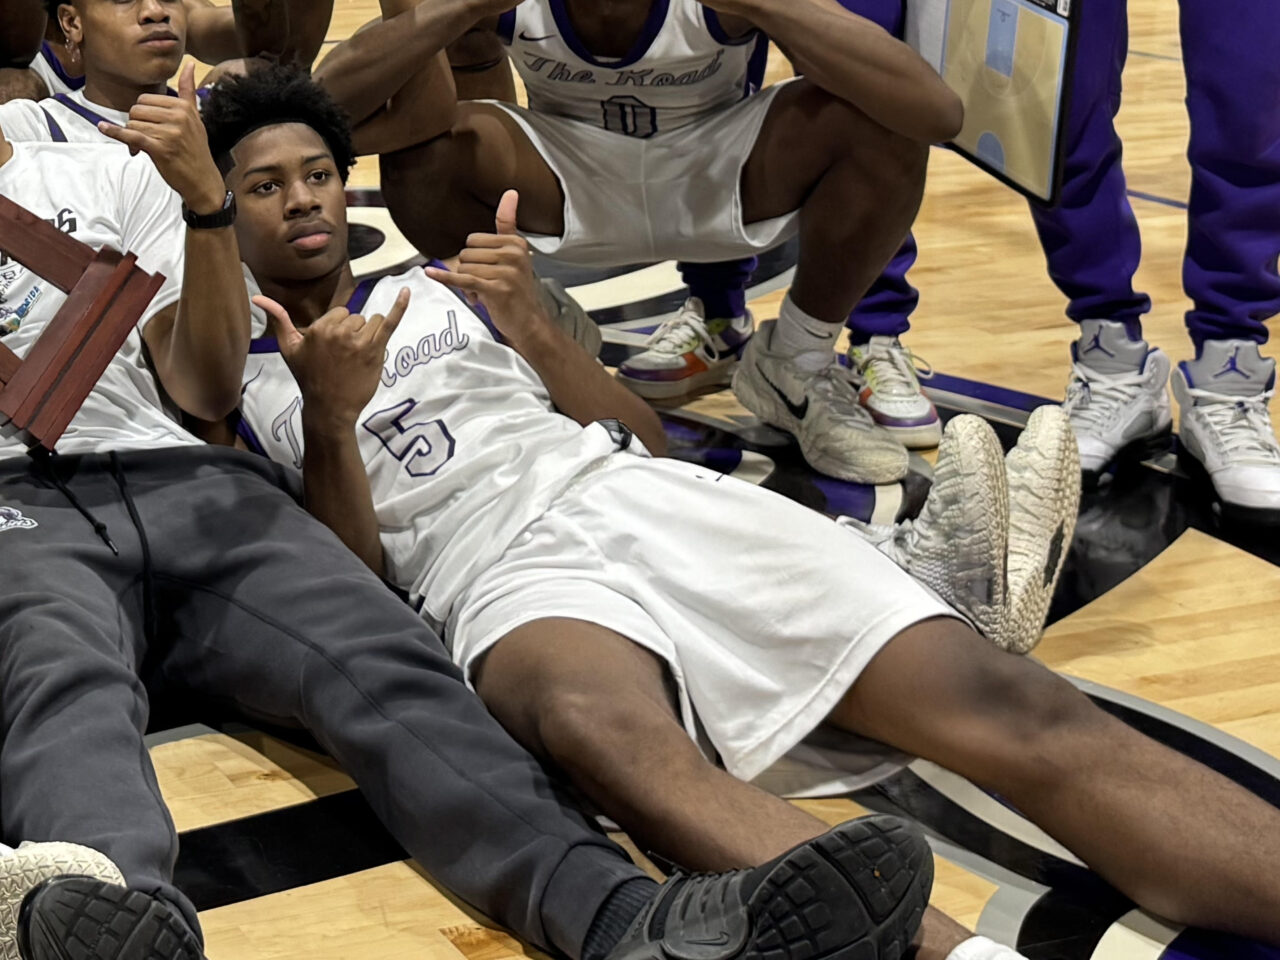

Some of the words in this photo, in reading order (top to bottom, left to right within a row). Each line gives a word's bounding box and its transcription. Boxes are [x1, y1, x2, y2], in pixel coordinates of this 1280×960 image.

[523, 51, 596, 84] The
[605, 48, 725, 87] Road
[361, 397, 457, 478] 5
